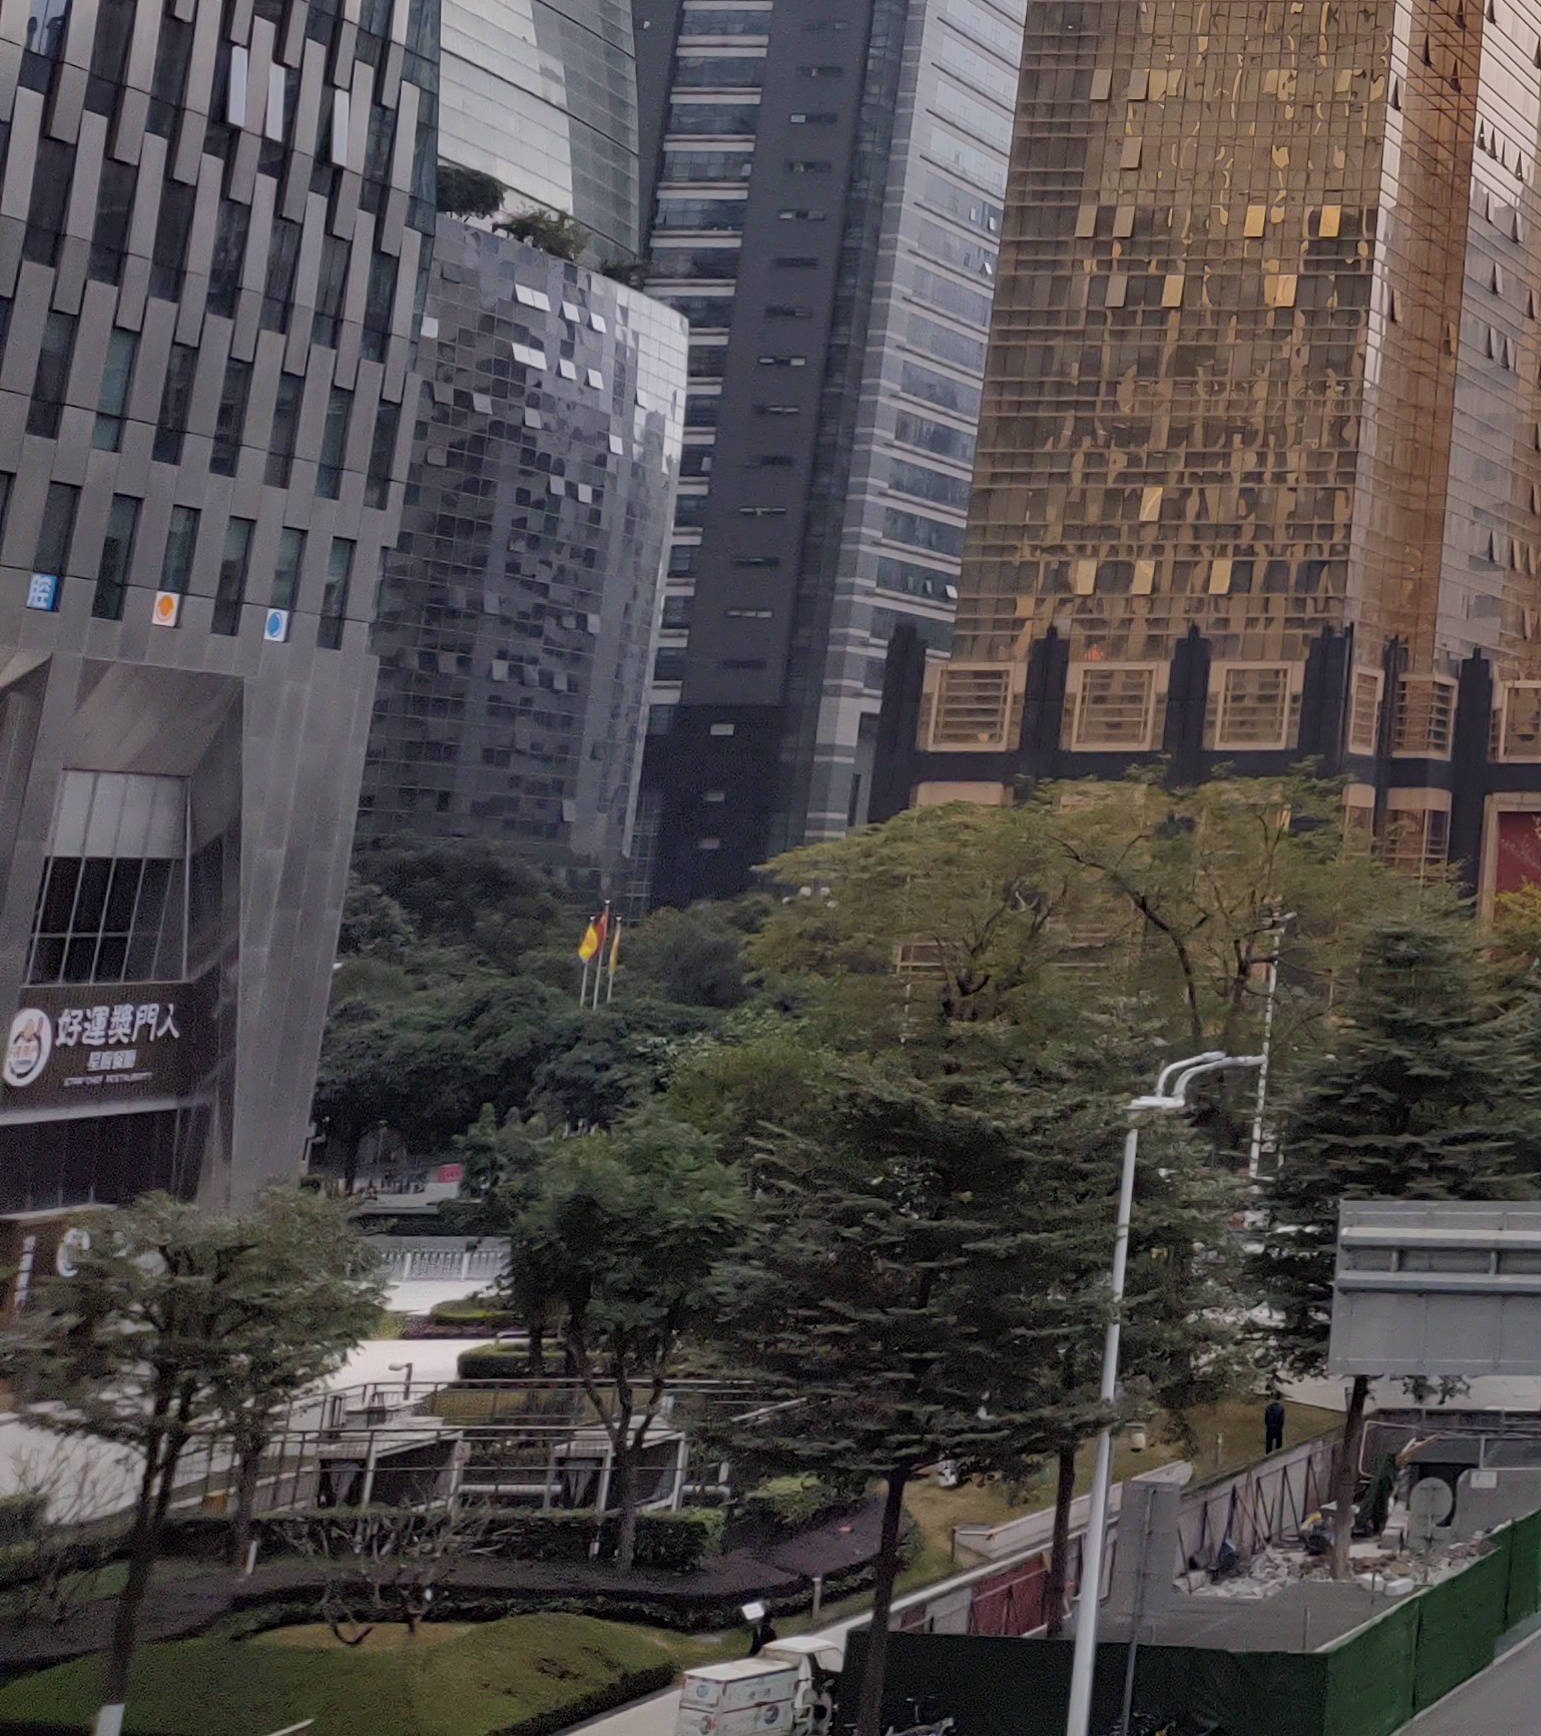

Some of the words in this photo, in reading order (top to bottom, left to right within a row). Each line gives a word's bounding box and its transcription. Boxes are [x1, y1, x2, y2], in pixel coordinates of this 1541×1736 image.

[55, 1002, 180, 1047] 好運獎門人
